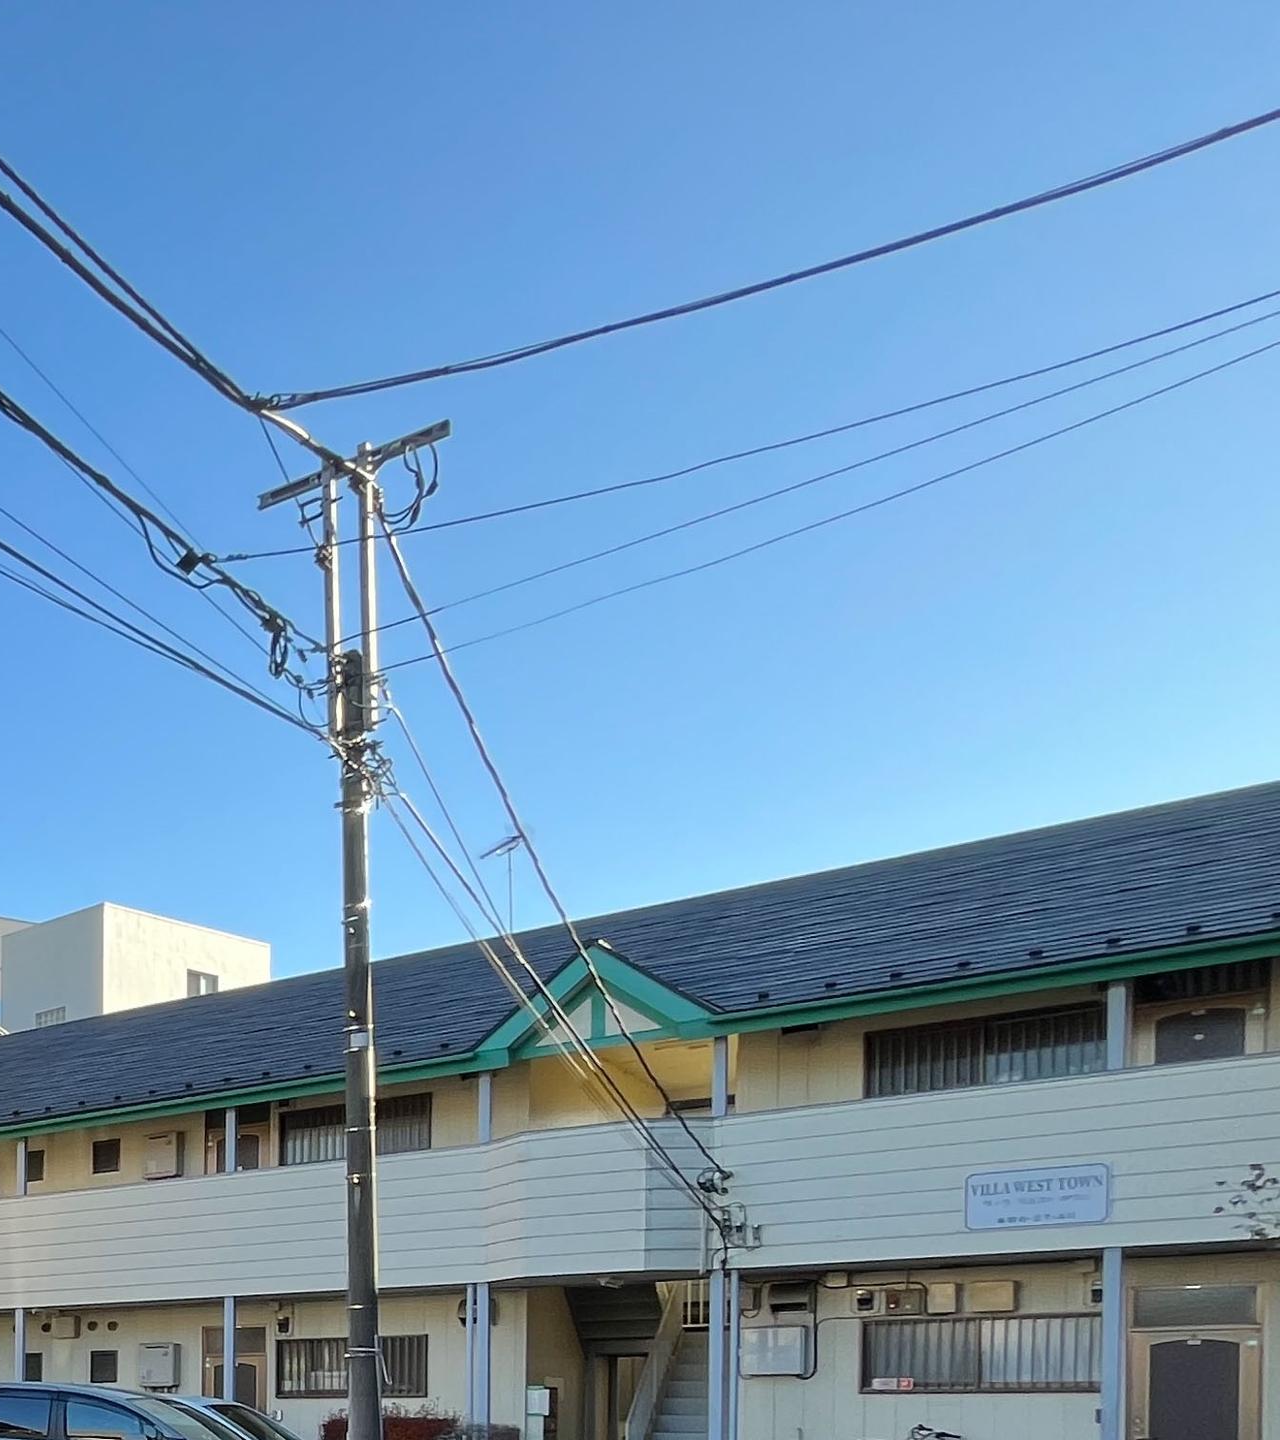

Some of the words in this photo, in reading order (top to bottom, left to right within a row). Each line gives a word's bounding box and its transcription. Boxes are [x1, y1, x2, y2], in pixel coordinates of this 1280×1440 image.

[971, 1183, 1010, 1197] VILLA
[1013, 1178, 1053, 1192] WEST
[1059, 1175, 1103, 1191] TOWN
